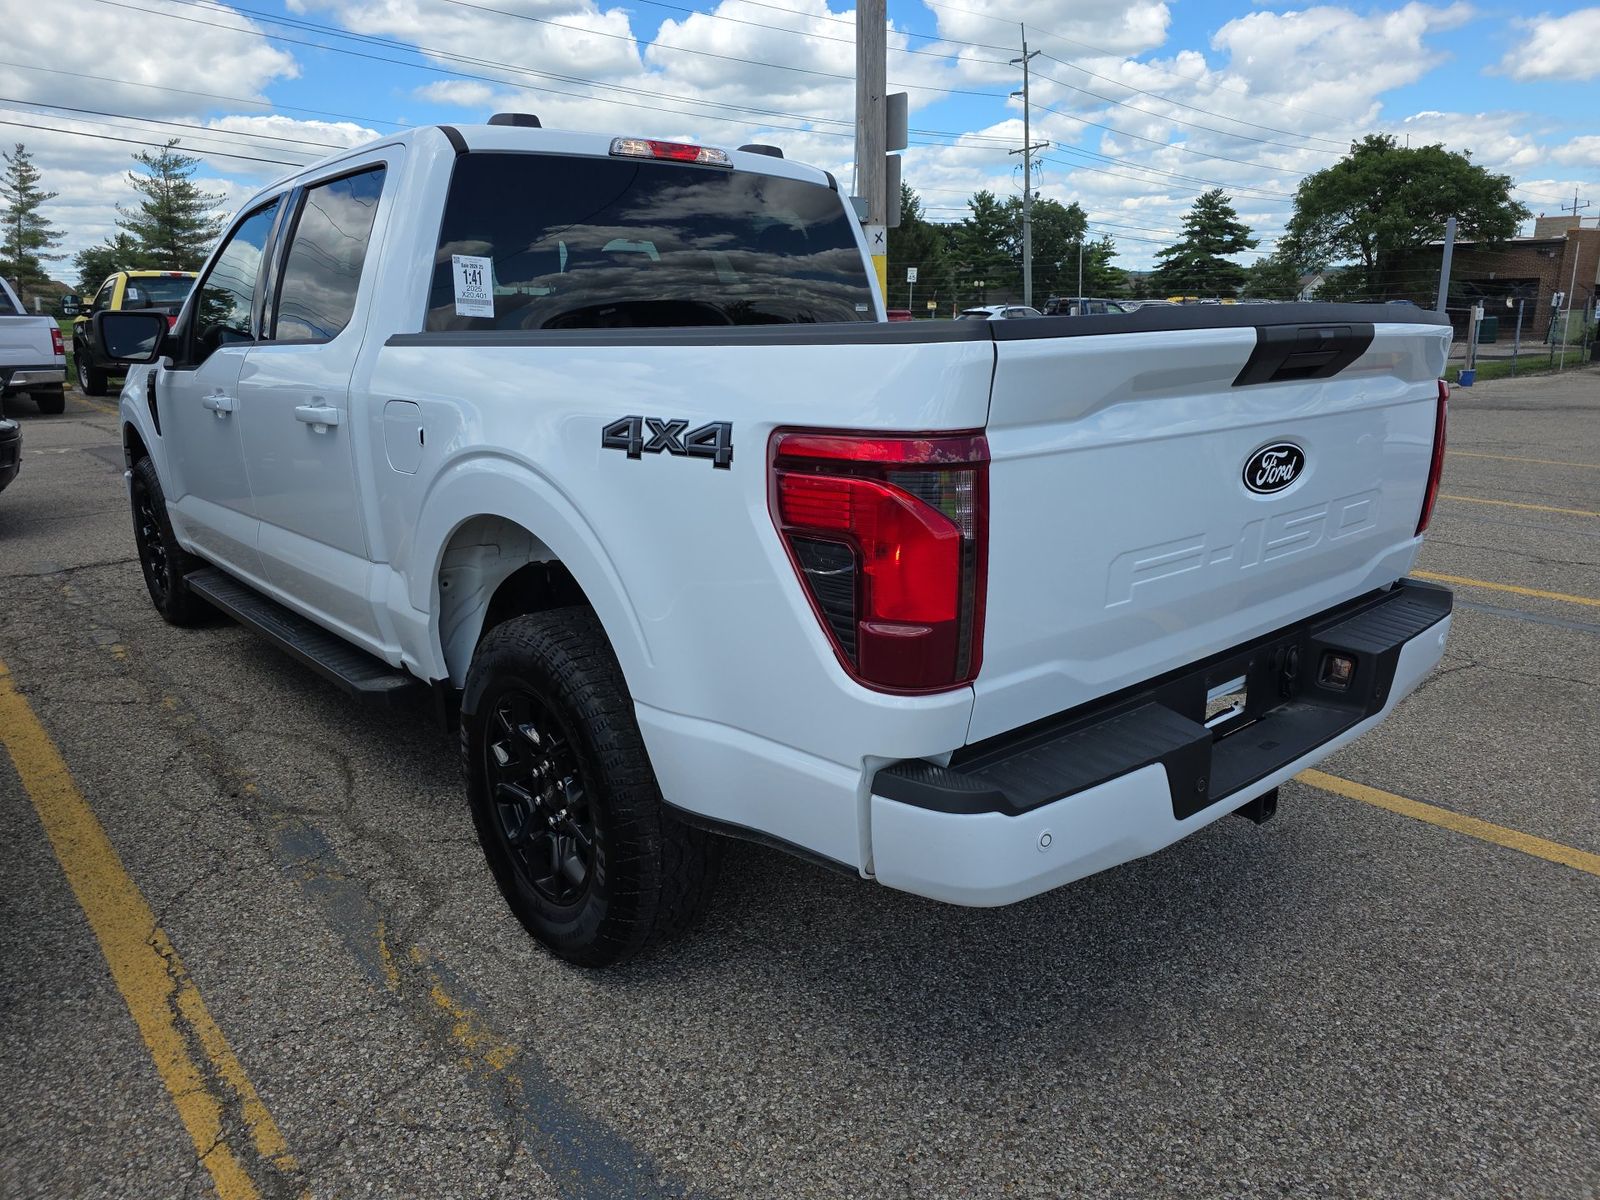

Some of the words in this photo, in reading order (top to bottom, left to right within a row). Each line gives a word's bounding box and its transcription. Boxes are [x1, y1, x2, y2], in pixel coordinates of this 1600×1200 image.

[462, 269, 482, 285] 1:41
[1256, 451, 1297, 486] Ford
[1104, 488, 1382, 609] F-150
